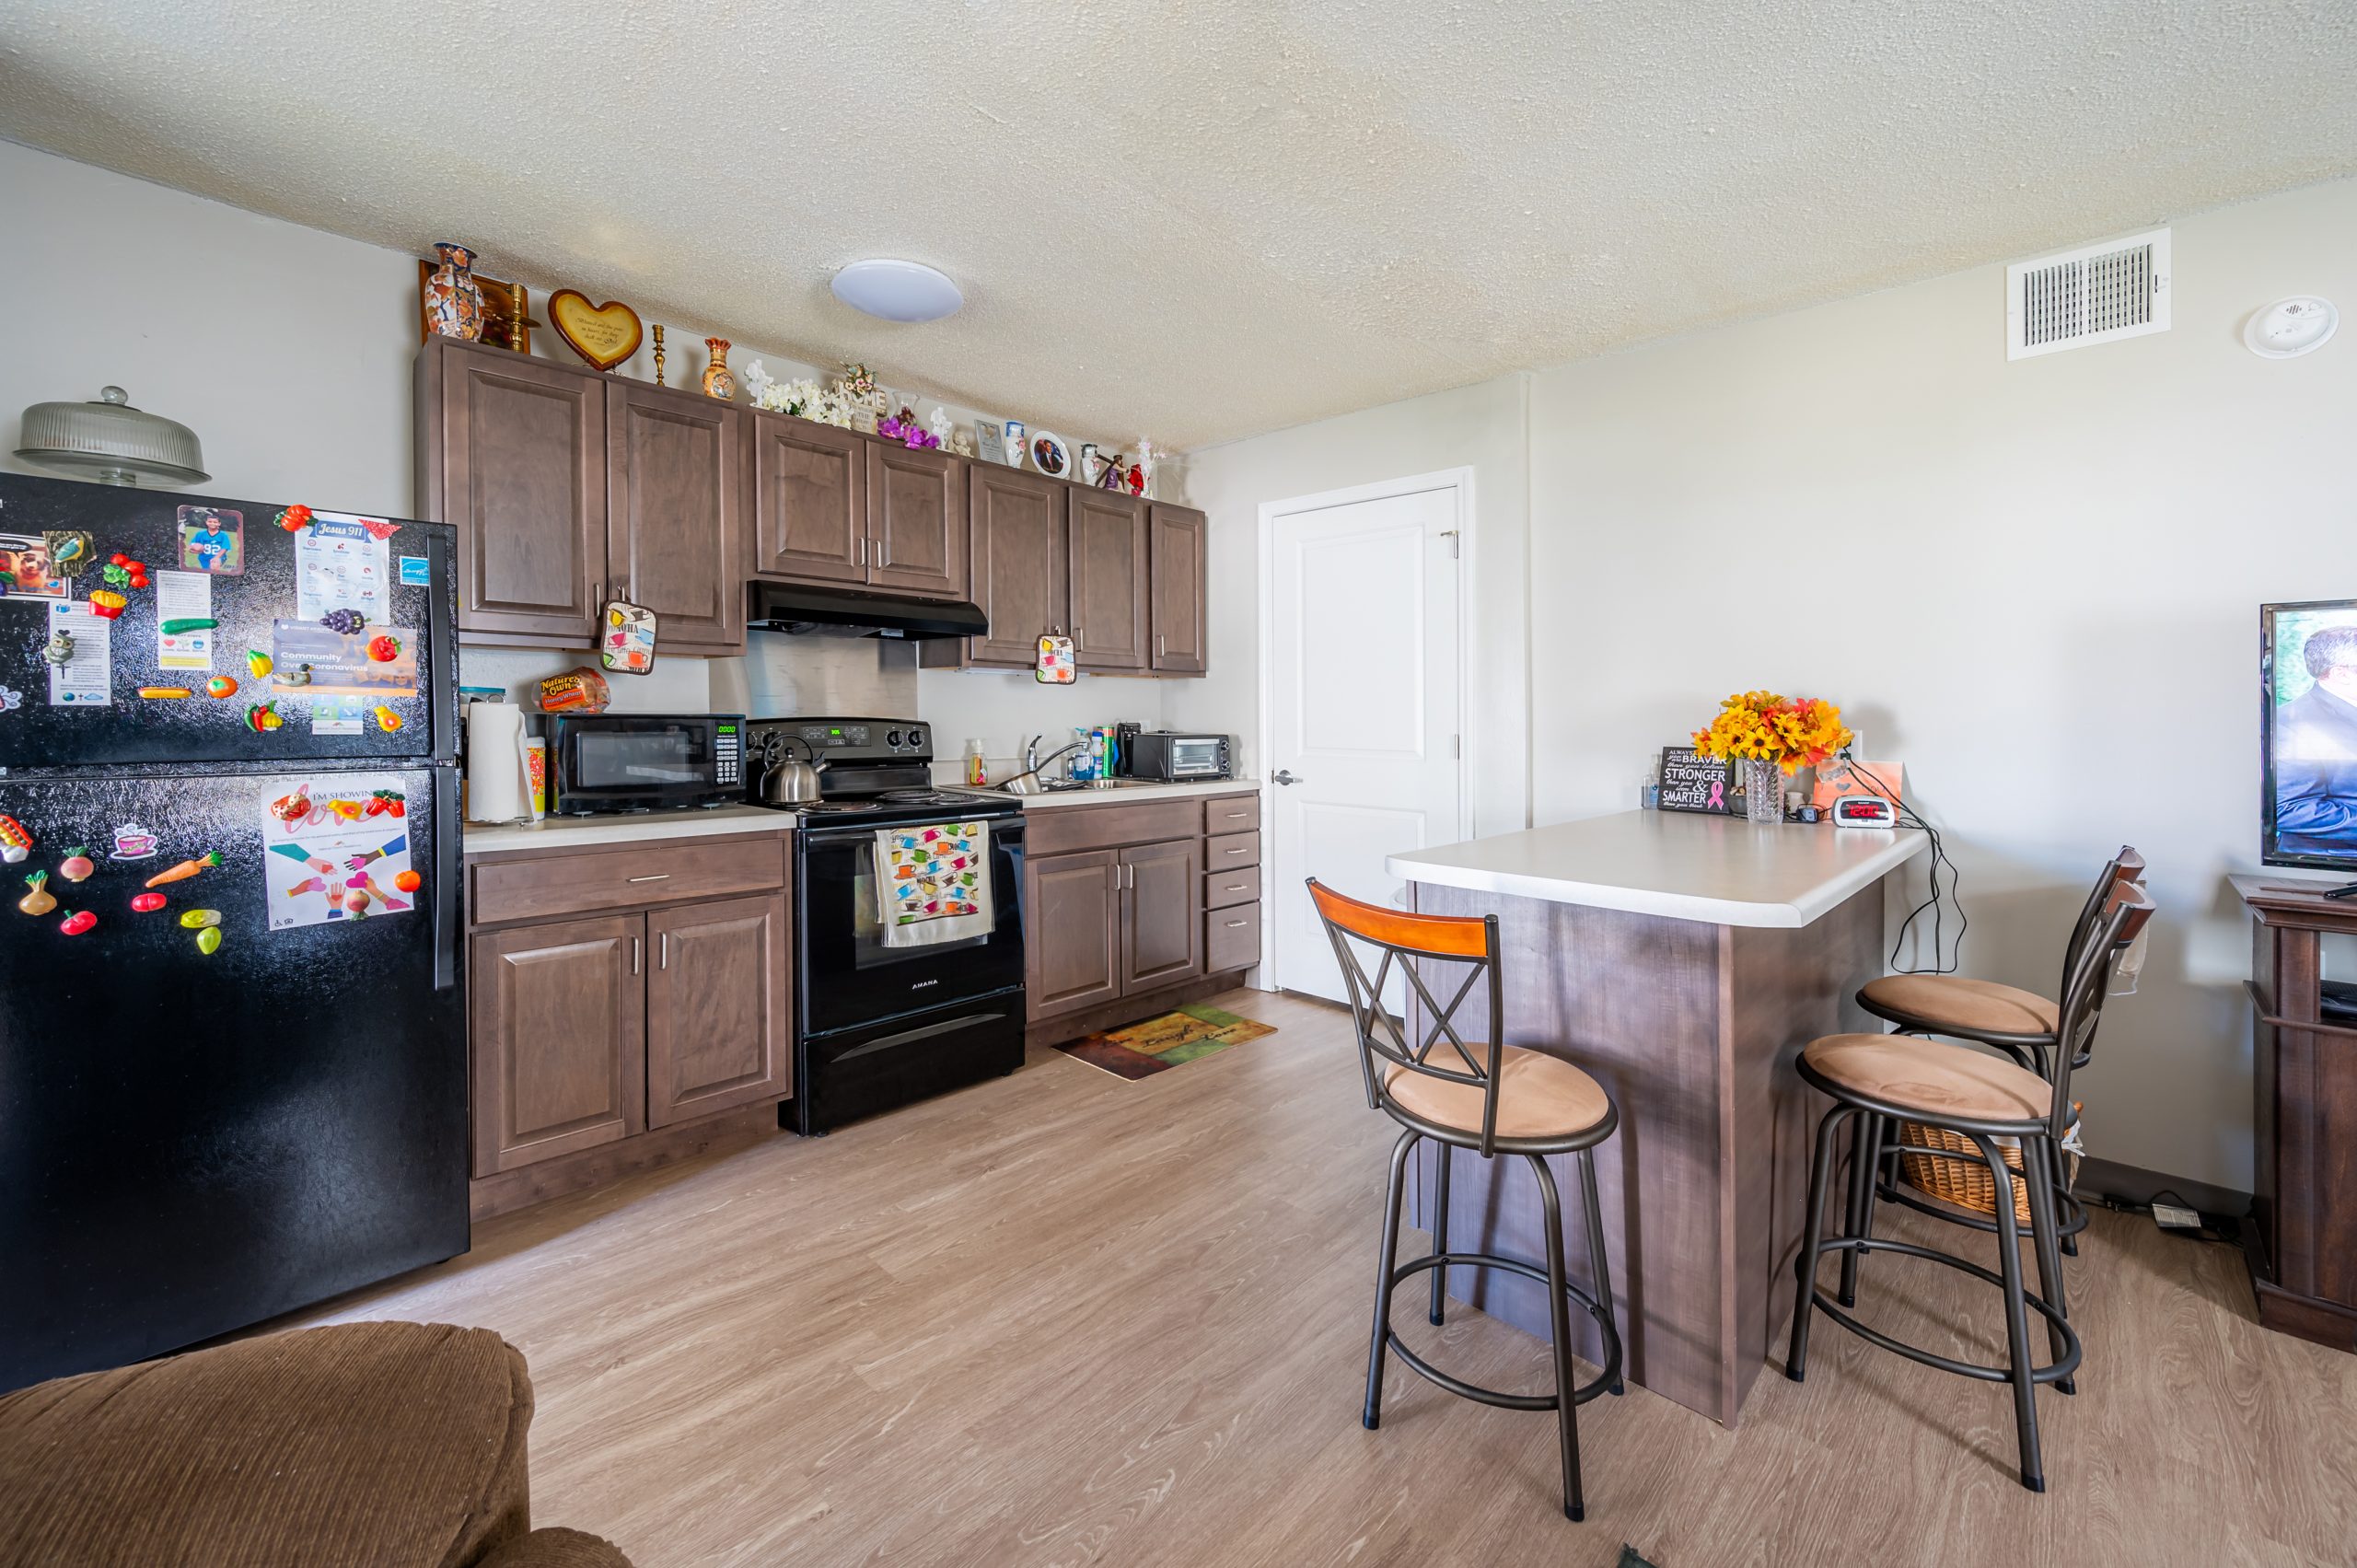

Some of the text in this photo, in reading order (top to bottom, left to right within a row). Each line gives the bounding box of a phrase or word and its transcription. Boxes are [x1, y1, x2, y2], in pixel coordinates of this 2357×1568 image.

[319, 523, 363, 537] Jesus 911
[281, 651, 342, 662] Community
[281, 661, 302, 669] Ove
[550, 682, 571, 696] Own
[545, 691, 582, 704] Honey Wheat
[1665, 768, 1725, 782] STRONGER
[1692, 779, 1709, 793] &
[313, 789, 373, 801] I'M SHOWIN
[1663, 790, 1707, 804] SMARTER
[911, 979, 938, 990] AMANA
